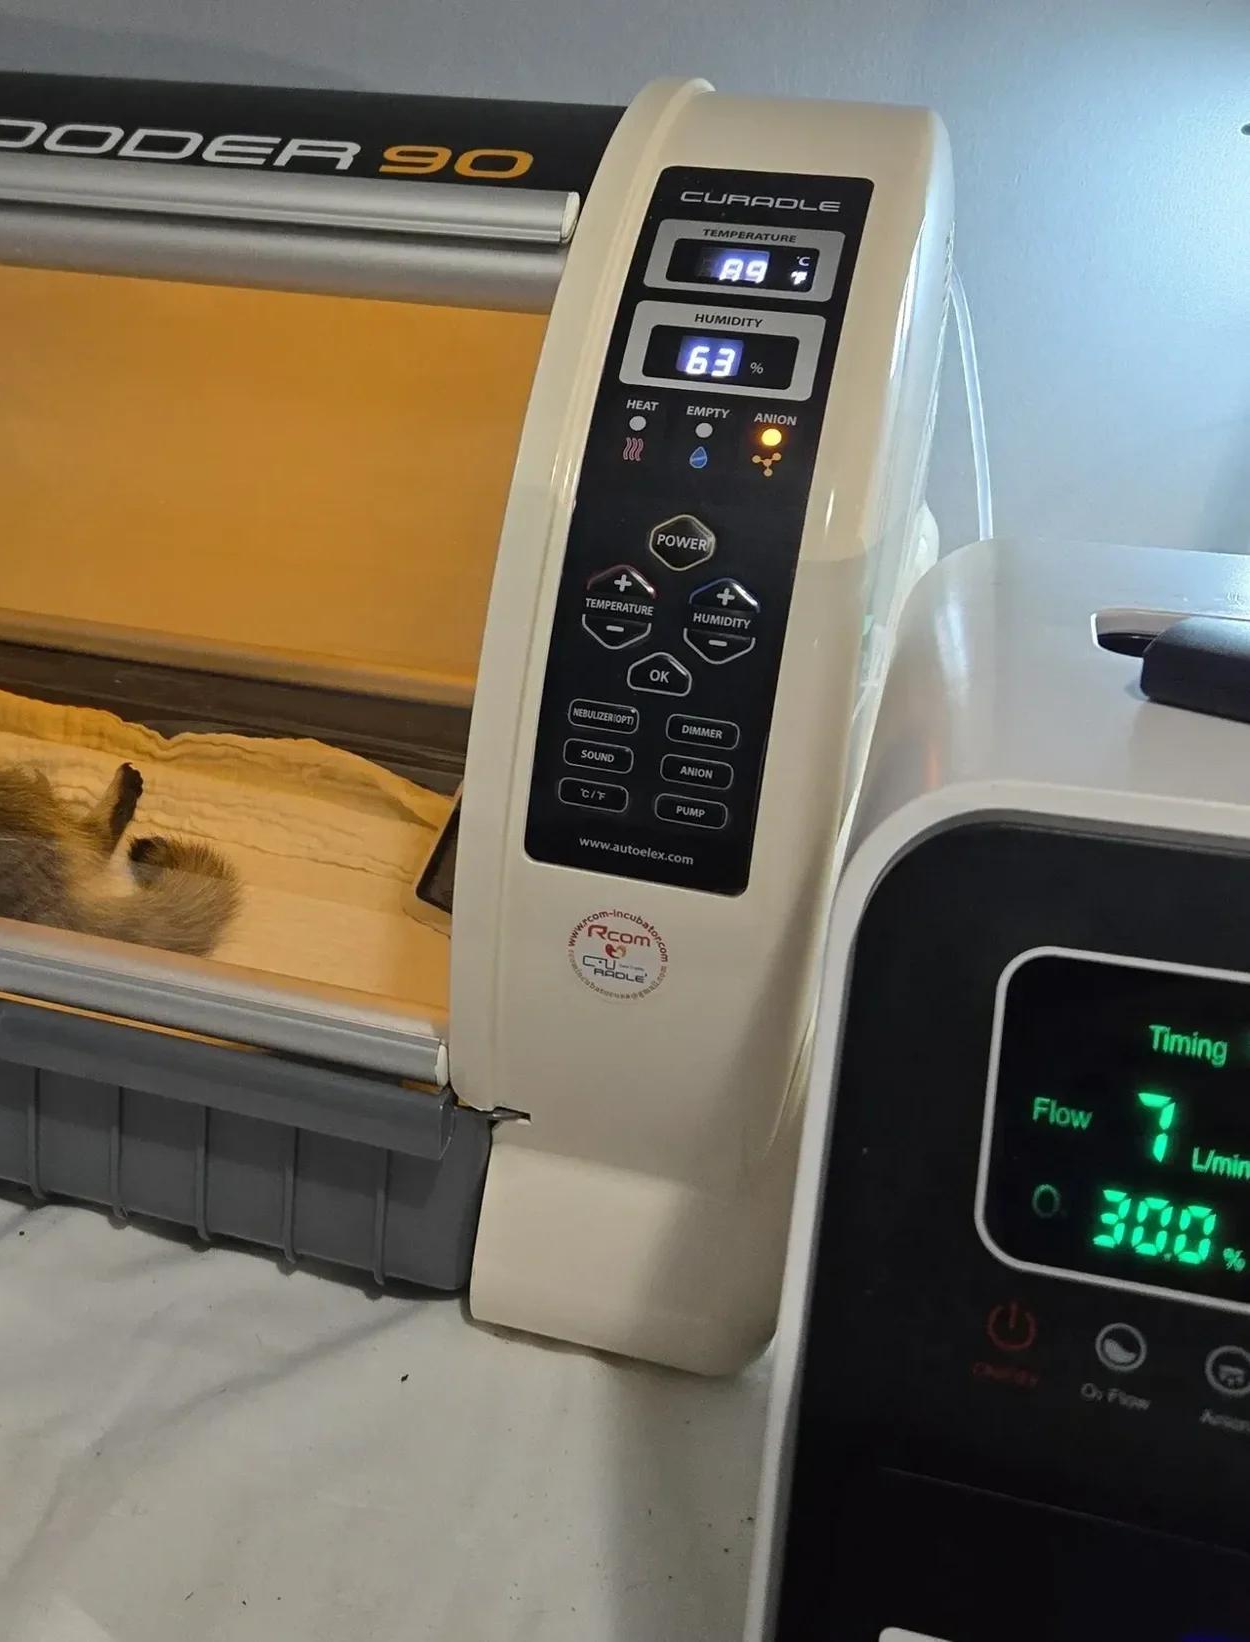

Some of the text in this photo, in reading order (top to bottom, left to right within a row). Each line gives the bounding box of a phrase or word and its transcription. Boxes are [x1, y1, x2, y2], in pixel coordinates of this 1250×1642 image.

[378, 145, 534, 179] 90
[680, 191, 841, 212] CURADLE
[702, 228, 797, 243] TEMPERATURE
[694, 313, 763, 328] HUMIDITY
[685, 345, 764, 377] 63 %
[626, 399, 659, 411] HEAT
[686, 405, 730, 419] EMPTY
[754, 412, 798, 426] ANION
[656, 533, 707, 551] POWER
[585, 597, 654, 616] TEMPERATURE
[693, 612, 751, 630] HUMIDITY
[649, 669, 670, 683] OK
[573, 707, 634, 726] NEBULIZER(OPT)
[681, 724, 723, 739] DIMMER
[581, 750, 615, 763] SOUND
[680, 765, 713, 779] ANION
[676, 805, 705, 818] PUMP
[579, 837, 694, 865] www.autoelex.com
[1149, 1024, 1228, 1068] Timing
[1032, 1097, 1093, 1130] Flow
[1138, 1092, 1176, 1163] 7
[1093, 1189, 1216, 1265] 30.0
[1223, 1248, 1246, 1272] %
